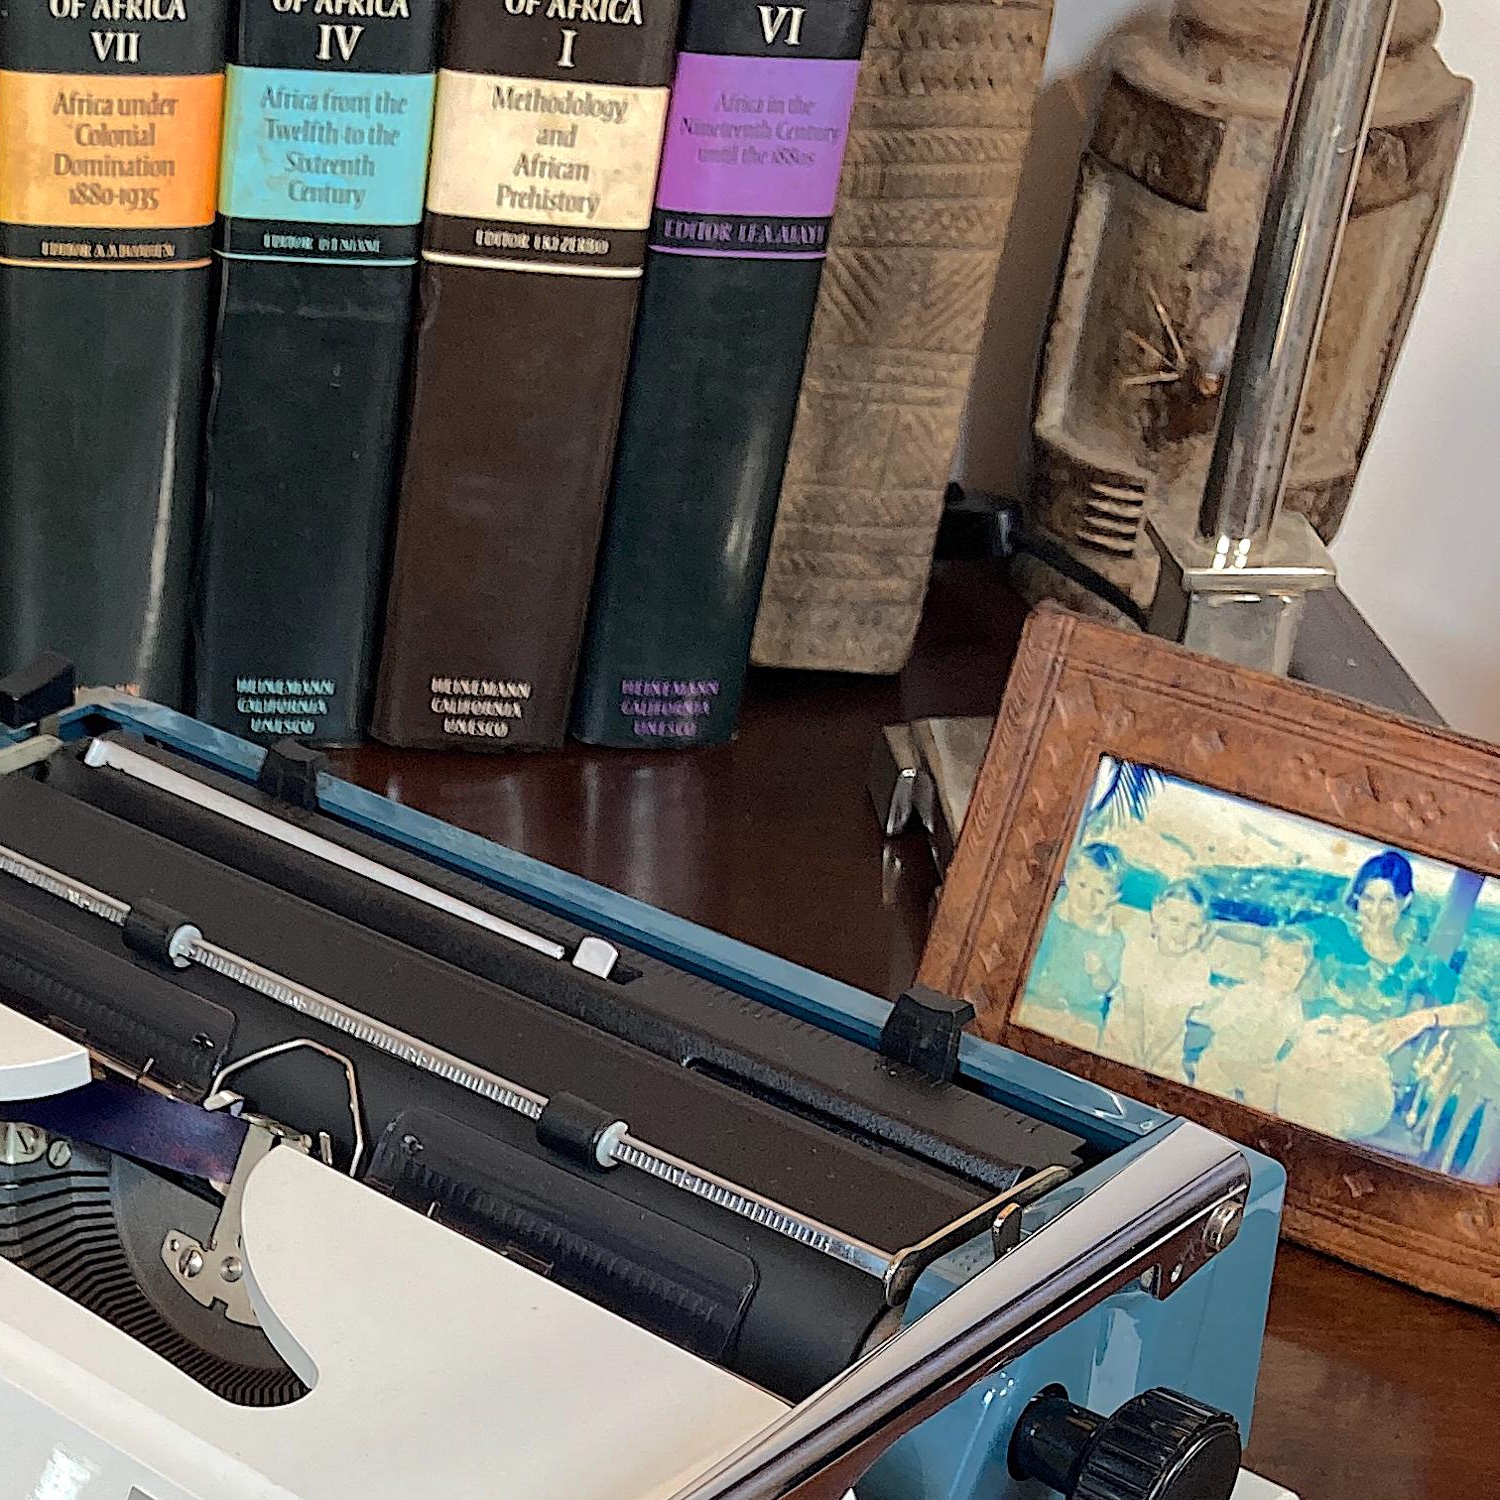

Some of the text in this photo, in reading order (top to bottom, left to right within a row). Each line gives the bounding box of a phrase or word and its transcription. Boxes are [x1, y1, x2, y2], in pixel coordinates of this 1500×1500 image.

[91, 0, 187, 21] AFRICA
[546, 0, 643, 26] AFRICA
[757, 5, 811, 45] VI
[90, 31, 141, 64] VII
[316, 25, 365, 62] IV
[556, 29, 579, 68] I
[52, 90, 179, 117] Africa under
[260, 85, 408, 116] Africa from the
[492, 86, 628, 122] Methodology
[75, 122, 155, 147] Colonial
[264, 117, 400, 146] Twelfth to the
[536, 122, 578, 148] and
[54, 152, 176, 177] Domination
[284, 151, 375, 177] Sixteenth
[513, 152, 589, 182] African
[68, 182, 159, 211] 1880-1935
[287, 179, 366, 209] Century
[496, 183, 601, 219] Prehistory
